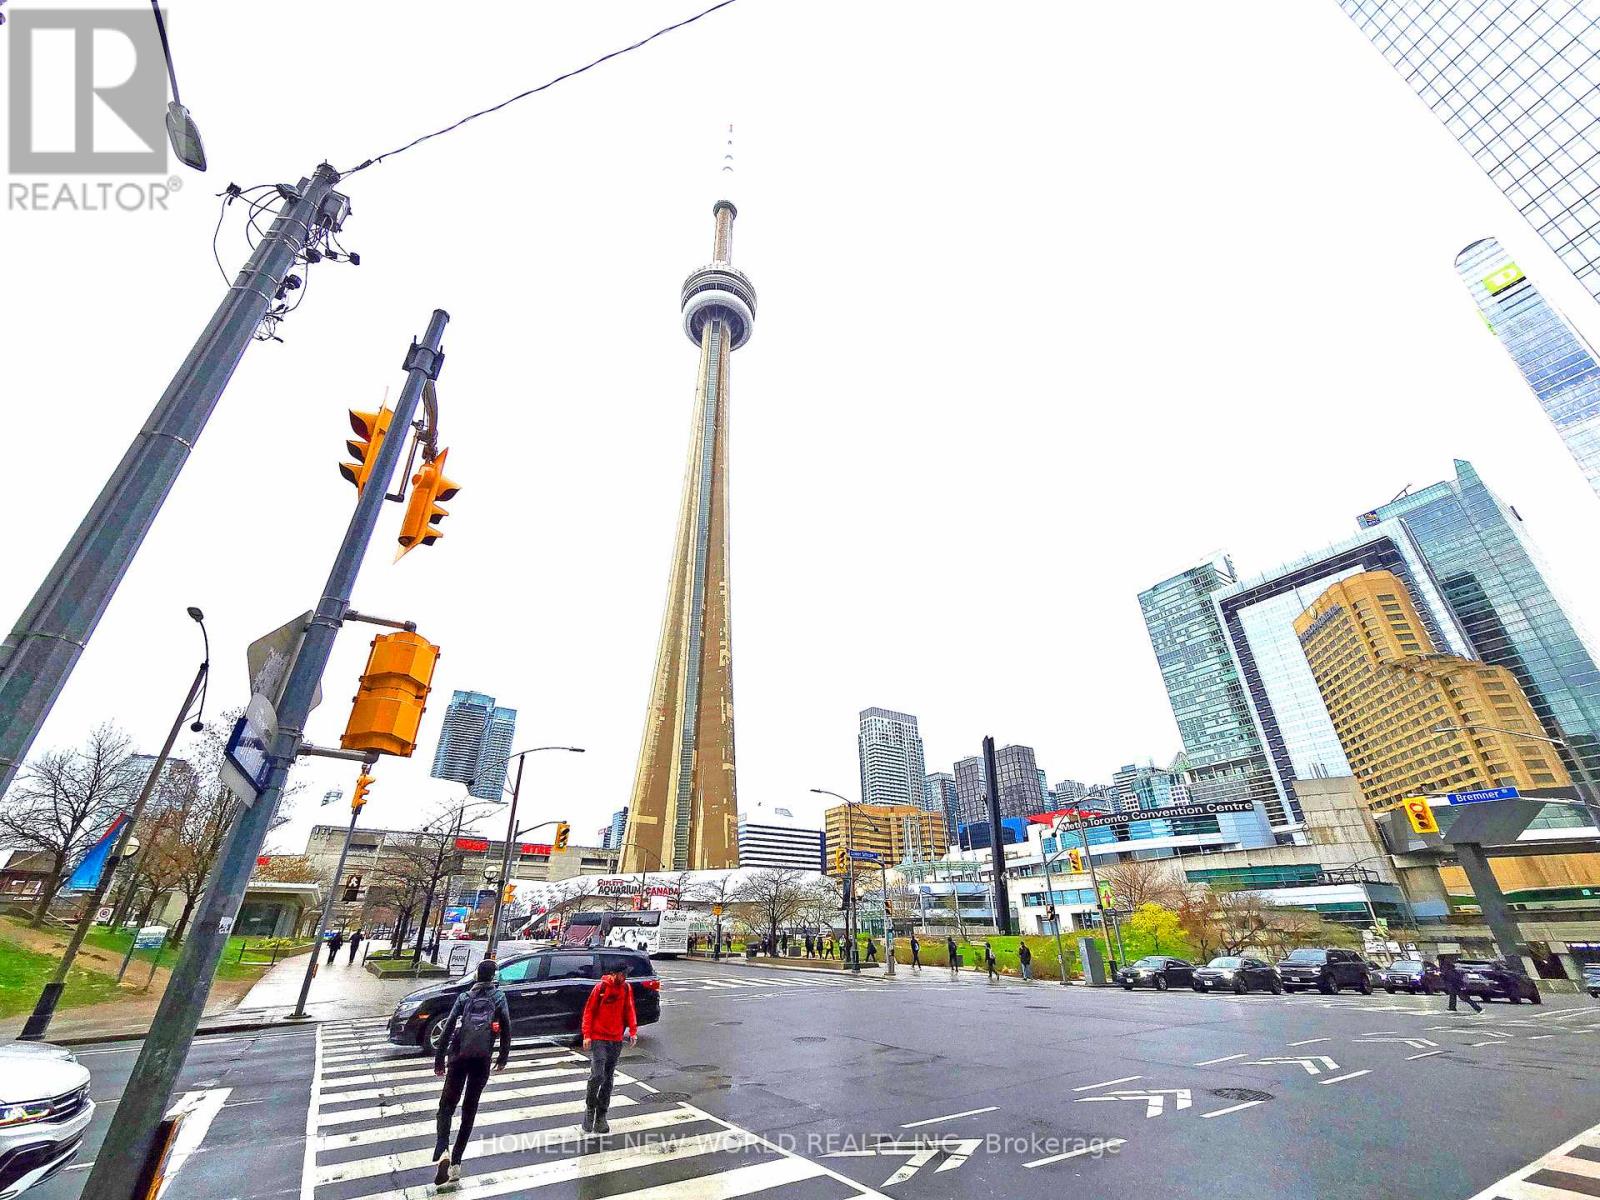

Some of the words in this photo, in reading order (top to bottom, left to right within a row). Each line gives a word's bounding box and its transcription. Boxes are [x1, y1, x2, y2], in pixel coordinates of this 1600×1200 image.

[1456, 791, 1499, 802] Bremner
[1090, 814, 1129, 826] Toronto
[1131, 806, 1203, 819] Convention
[1206, 802, 1253, 813] Centre
[598, 883, 641, 896] AQUARIUM
[645, 886, 680, 897] CANADA
